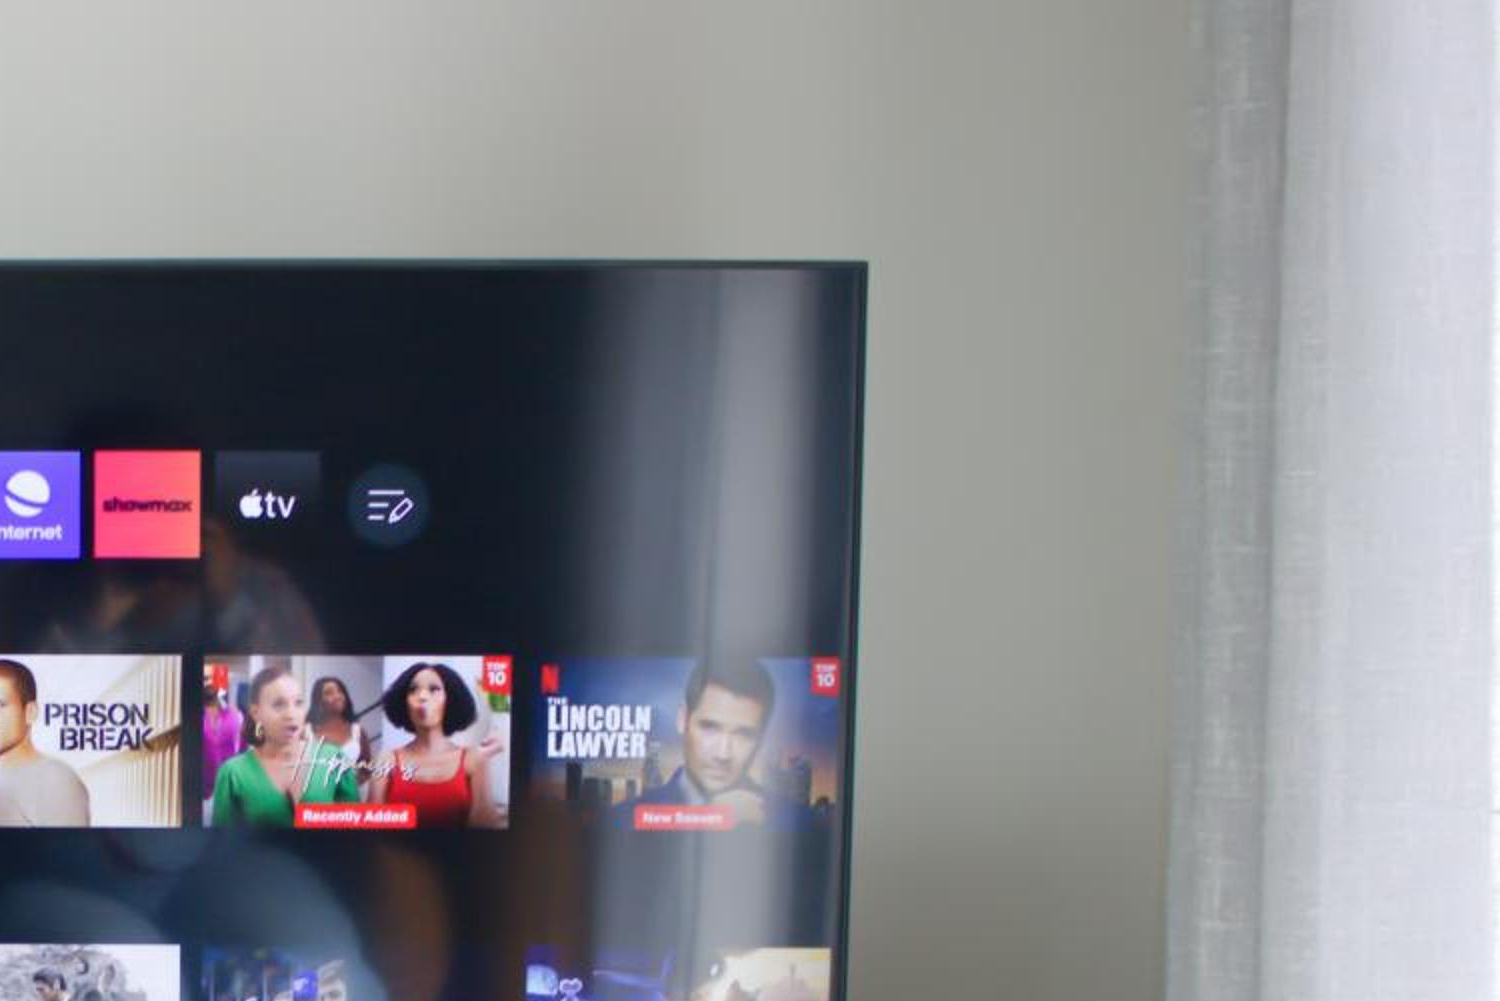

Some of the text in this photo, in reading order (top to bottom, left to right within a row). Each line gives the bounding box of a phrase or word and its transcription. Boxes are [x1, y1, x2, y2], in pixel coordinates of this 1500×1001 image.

[103, 497, 193, 514] showmax
[266, 490, 296, 519] tv
[488, 671, 507, 687] 10
[816, 672, 835, 688] 10
[45, 703, 149, 726] PRISON
[547, 704, 651, 731] LINCOLN
[59, 727, 153, 751] BREAK
[547, 731, 646, 758] LAWYER
[303, 809, 408, 824] Recently Added
